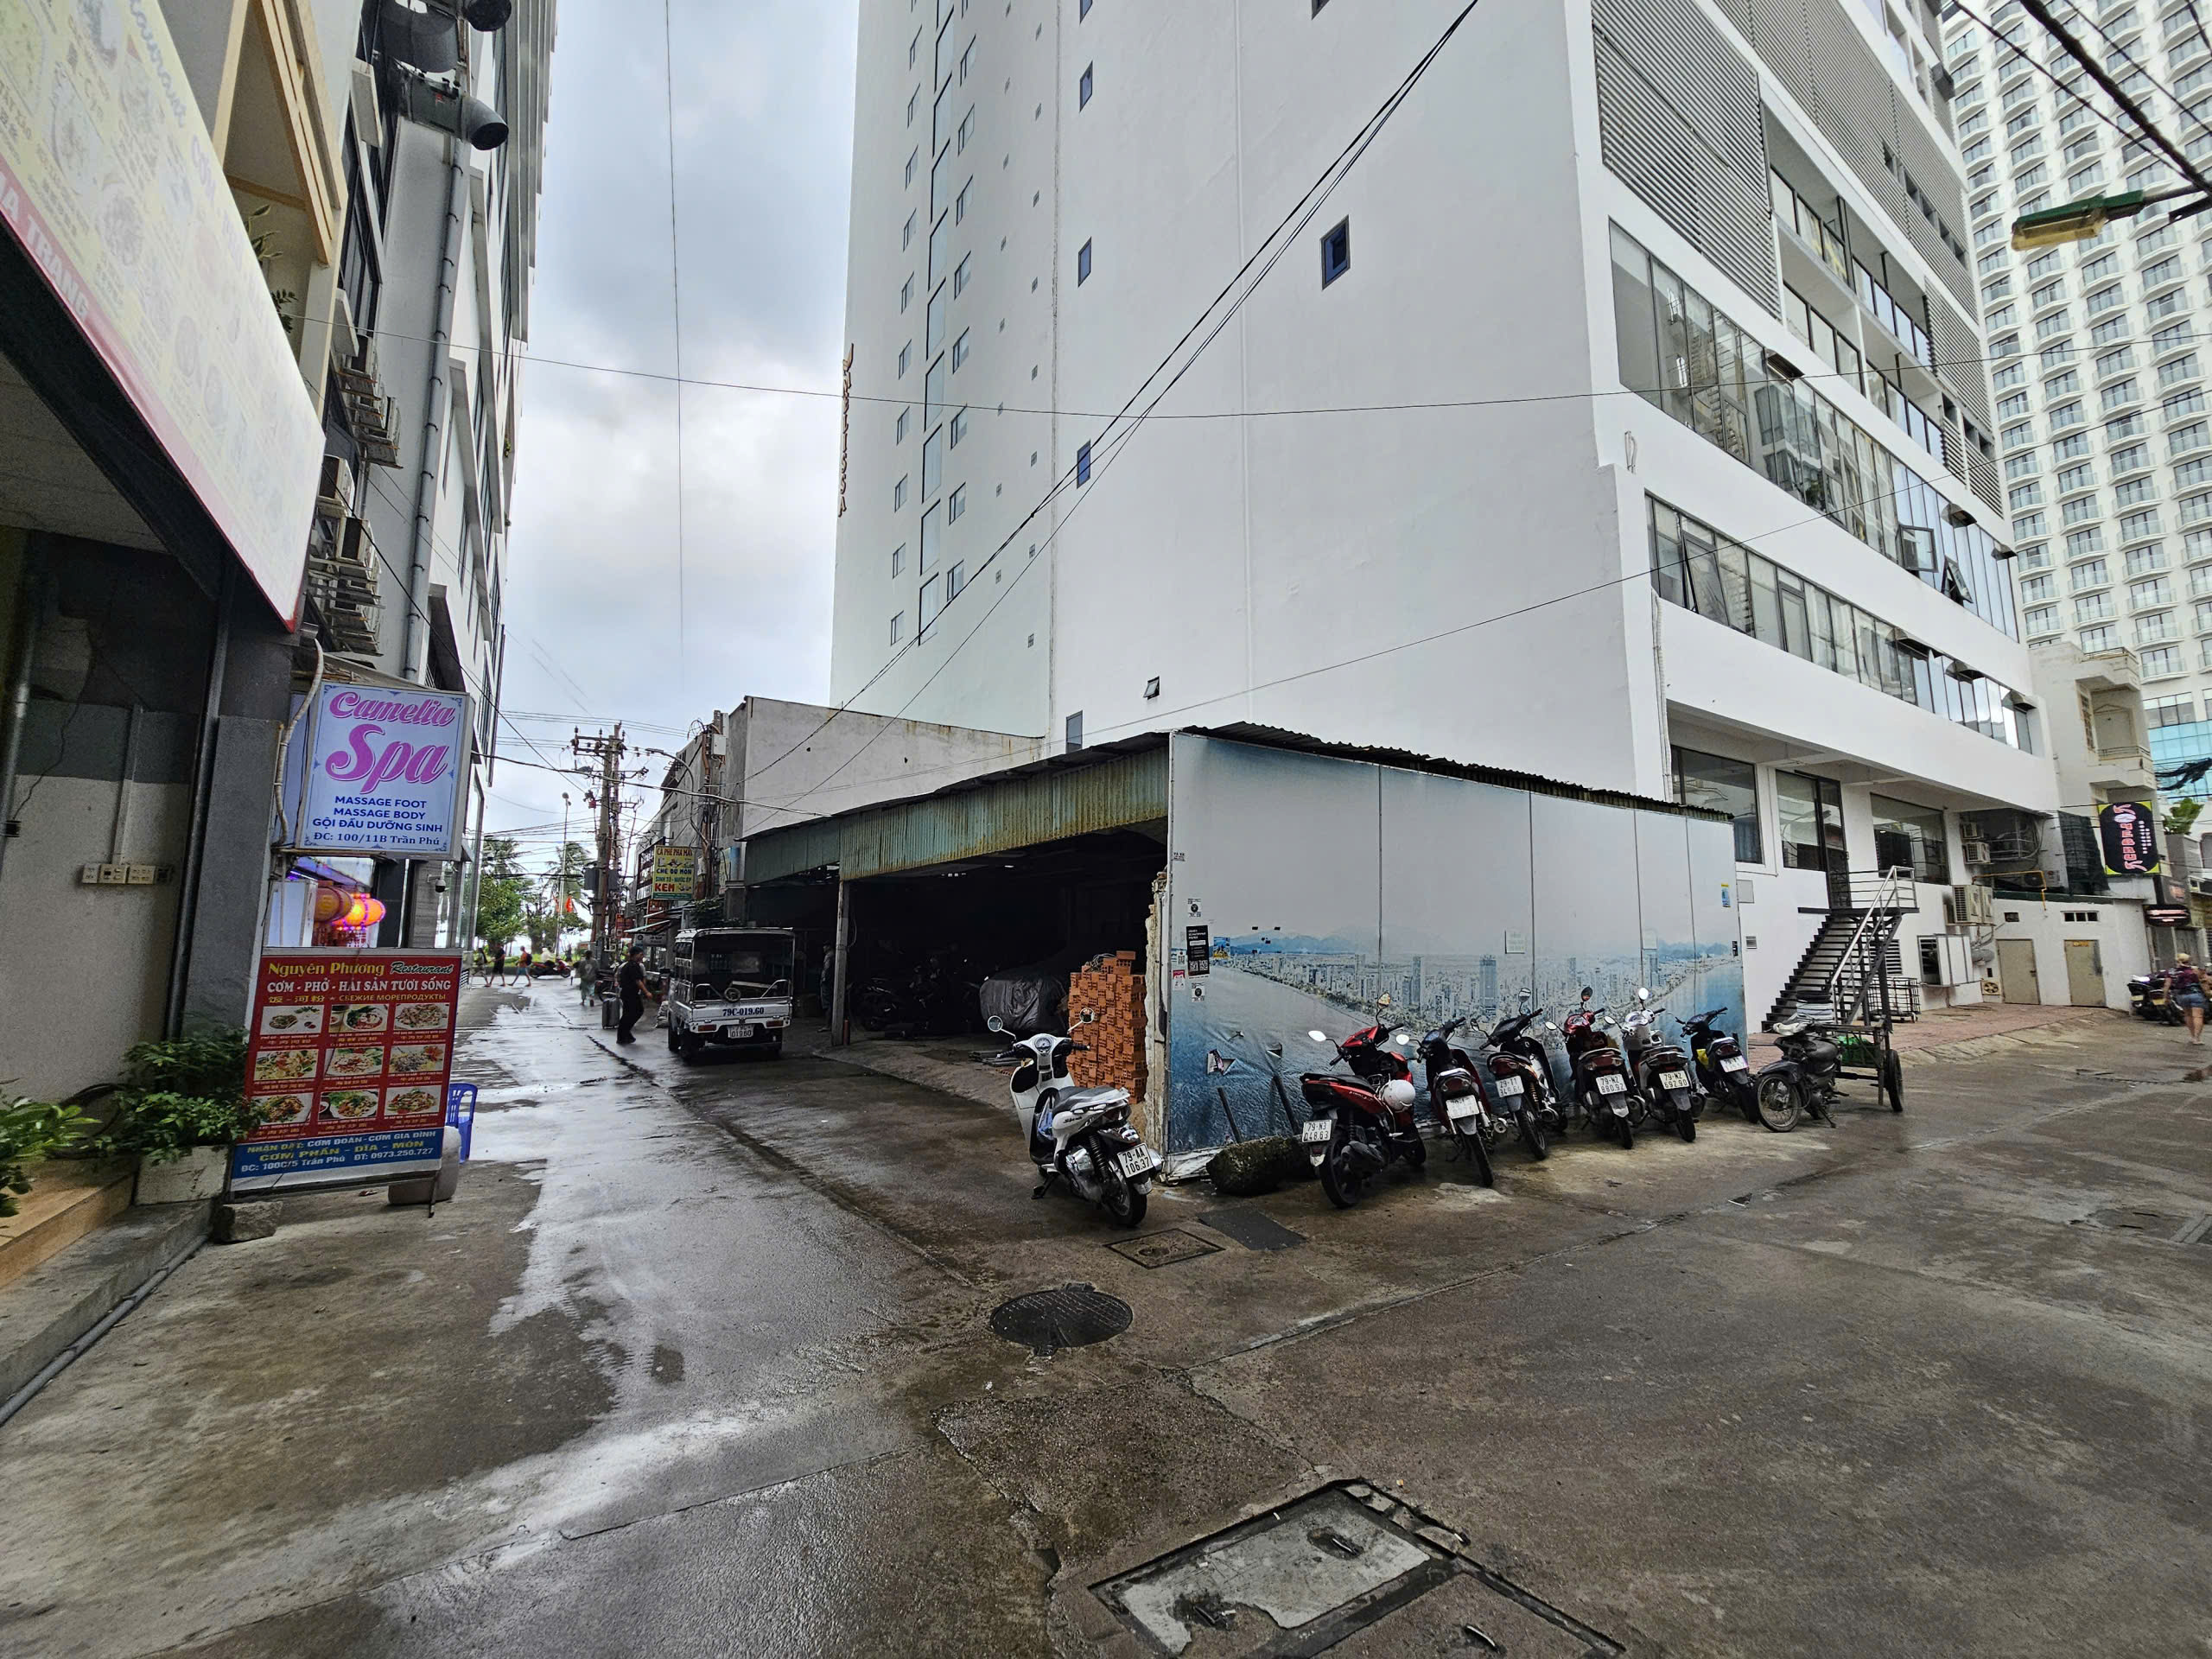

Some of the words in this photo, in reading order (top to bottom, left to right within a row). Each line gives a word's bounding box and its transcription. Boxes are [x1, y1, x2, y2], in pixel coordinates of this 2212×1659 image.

[27, 212, 90, 323] TRANG
[329, 691, 455, 726] Camelia
[325, 723, 449, 794] Spa
[334, 796, 391, 806] MASSAGE
[394, 799, 427, 809] FOOT
[334, 808, 391, 818] MASSAGE
[393, 810, 426, 820] BODY
[313, 817, 335, 830] GỘI
[416, 823, 442, 832] SINH
[314, 832, 334, 841] ĐC:
[338, 832, 387, 843] 100/11B
[391, 834, 416, 845] Trần
[419, 836, 440, 845] Phú
[655, 883, 676, 892] KEM
[268, 963, 325, 977] Nguyên
[330, 962, 385, 976] Phương
[389, 961, 454, 975] Restaurant
[267, 980, 295, 993] CƠM
[304, 977, 330, 992] PHỞ
[363, 976, 388, 991] SẢN
[391, 979, 419, 991] TƯƠI
[421, 976, 451, 990] SỐNG
[722, 1007, 765, 1016] 79C-019.60
[308, 1139, 332, 1147] CƠM
[353, 1153, 368, 1161] ĐT:
[371, 1147, 434, 1160] 0973.250.727
[1122, 1147, 1146, 1164] 79-AA
[1125, 1156, 1150, 1175] 106.37
